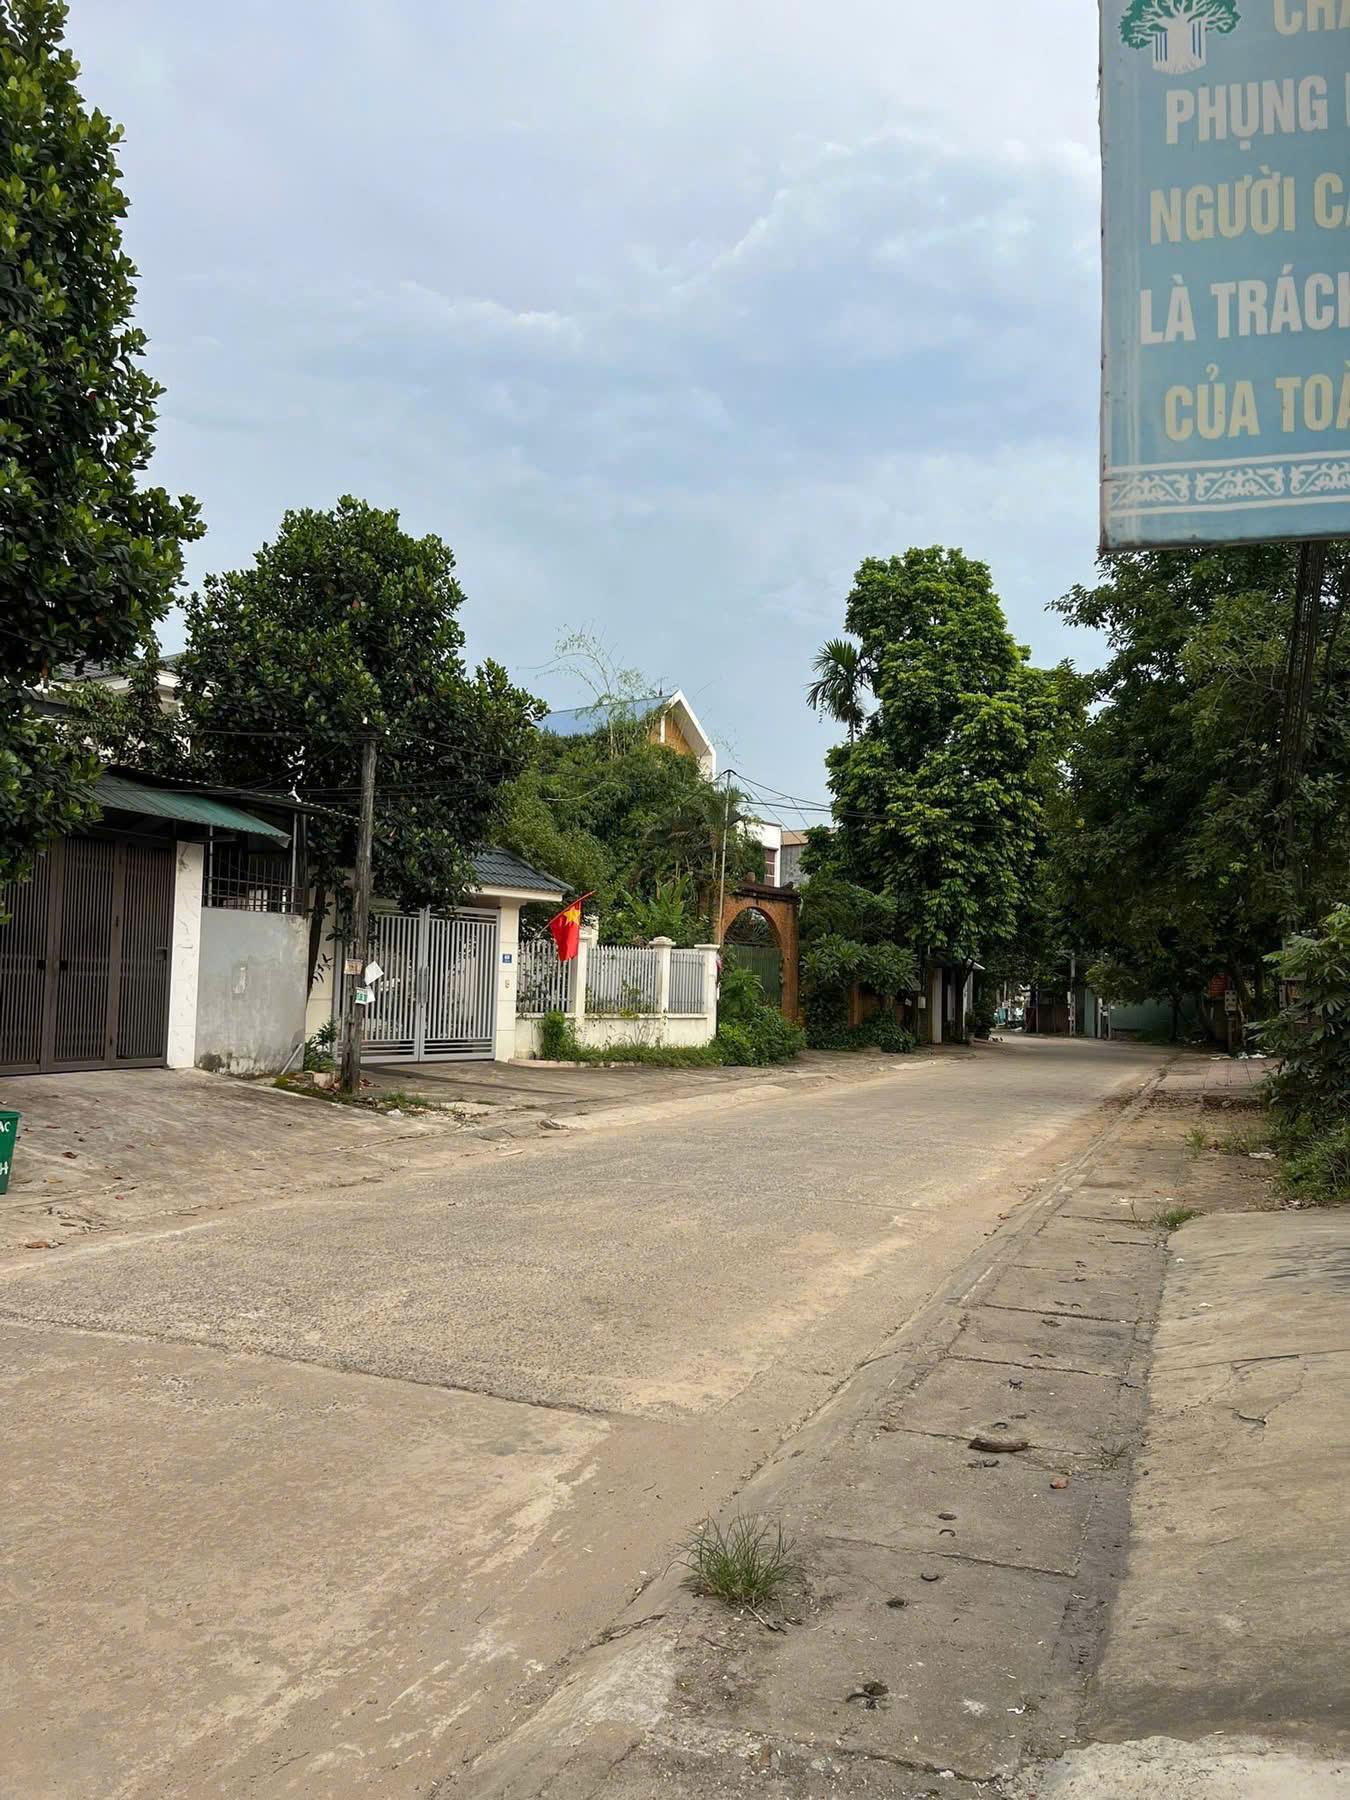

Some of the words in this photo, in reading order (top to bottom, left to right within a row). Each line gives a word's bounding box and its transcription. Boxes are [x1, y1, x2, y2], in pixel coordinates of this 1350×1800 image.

[1166, 75, 1328, 150] PHỤNG
[1150, 164, 1296, 245] NGƯỜI
[1314, 172, 1350, 229] C
[1140, 273, 1197, 345] LÀ
[1165, 363, 1260, 441] CỦA
